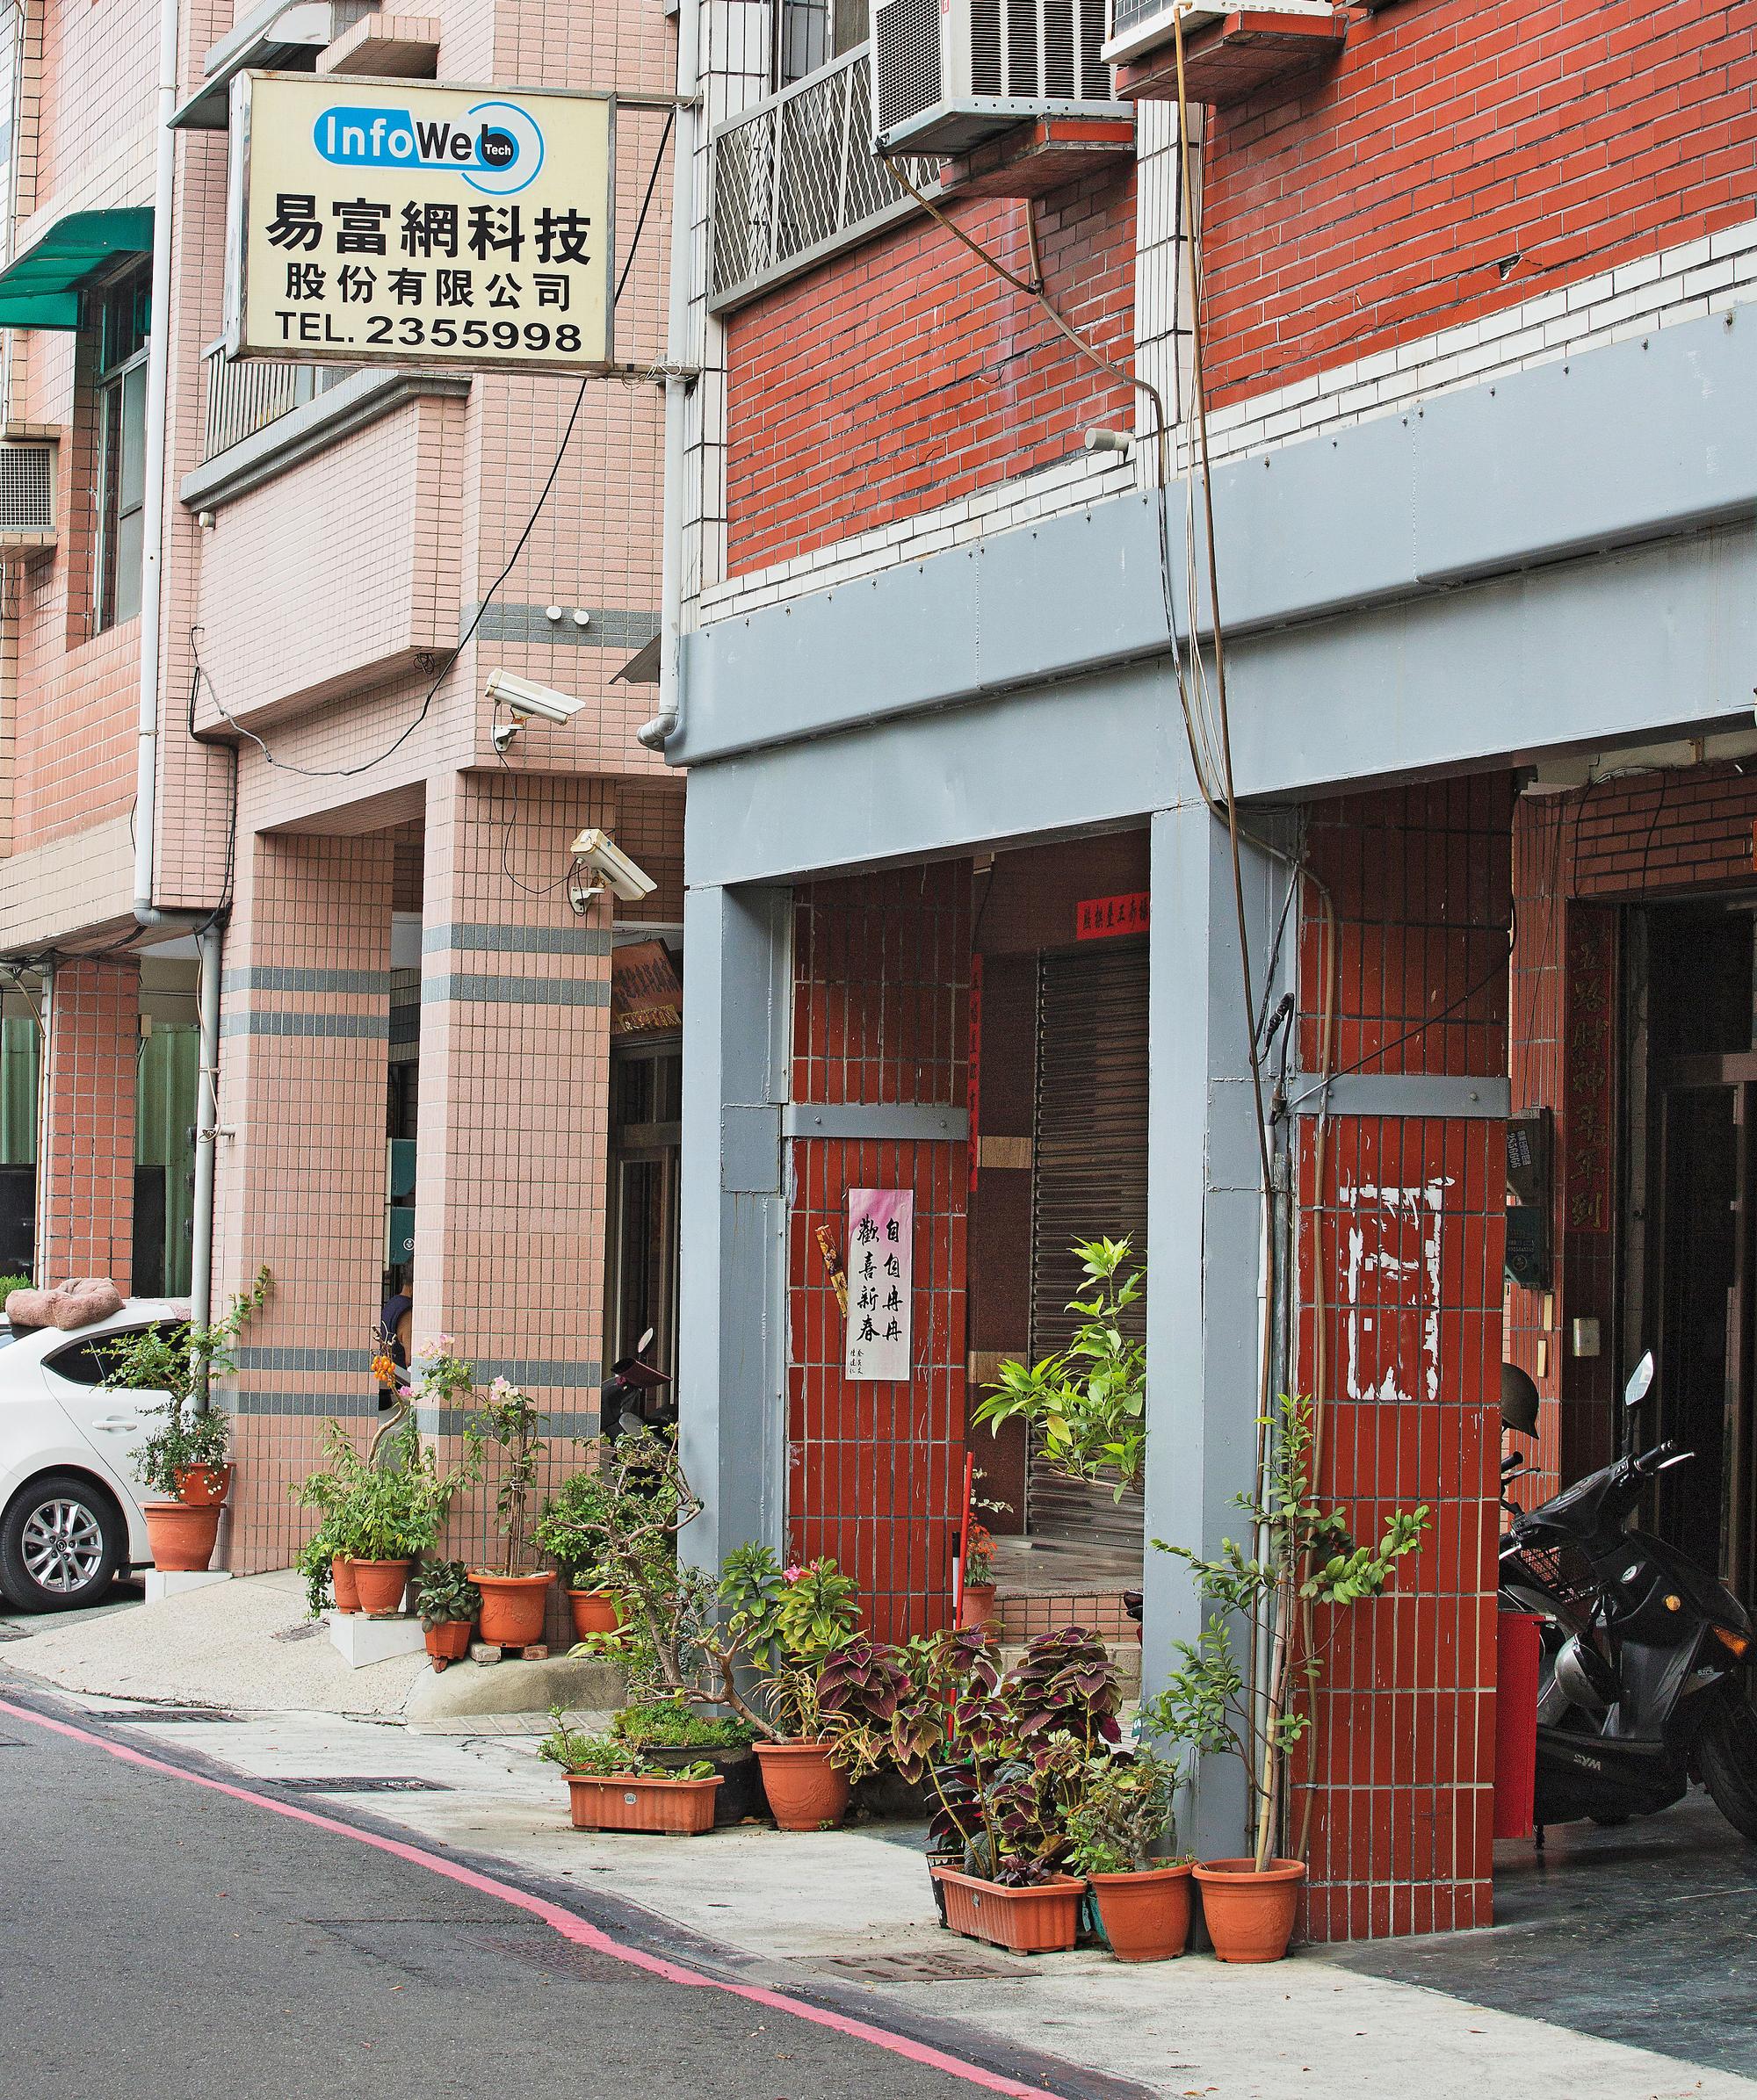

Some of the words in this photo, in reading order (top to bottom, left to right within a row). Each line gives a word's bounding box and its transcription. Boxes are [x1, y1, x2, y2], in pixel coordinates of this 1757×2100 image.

[327, 116, 514, 167] InfoWeb
[485, 143, 511, 155] Tech
[264, 192, 592, 266] 易富網科技
[285, 262, 571, 314] 股份有限公司
[275, 310, 353, 343] TEL.
[365, 314, 583, 352] 2355998
[856, 1213, 882, 1343] 歡喜新春
[881, 1217, 904, 1342] 自自冉冉
